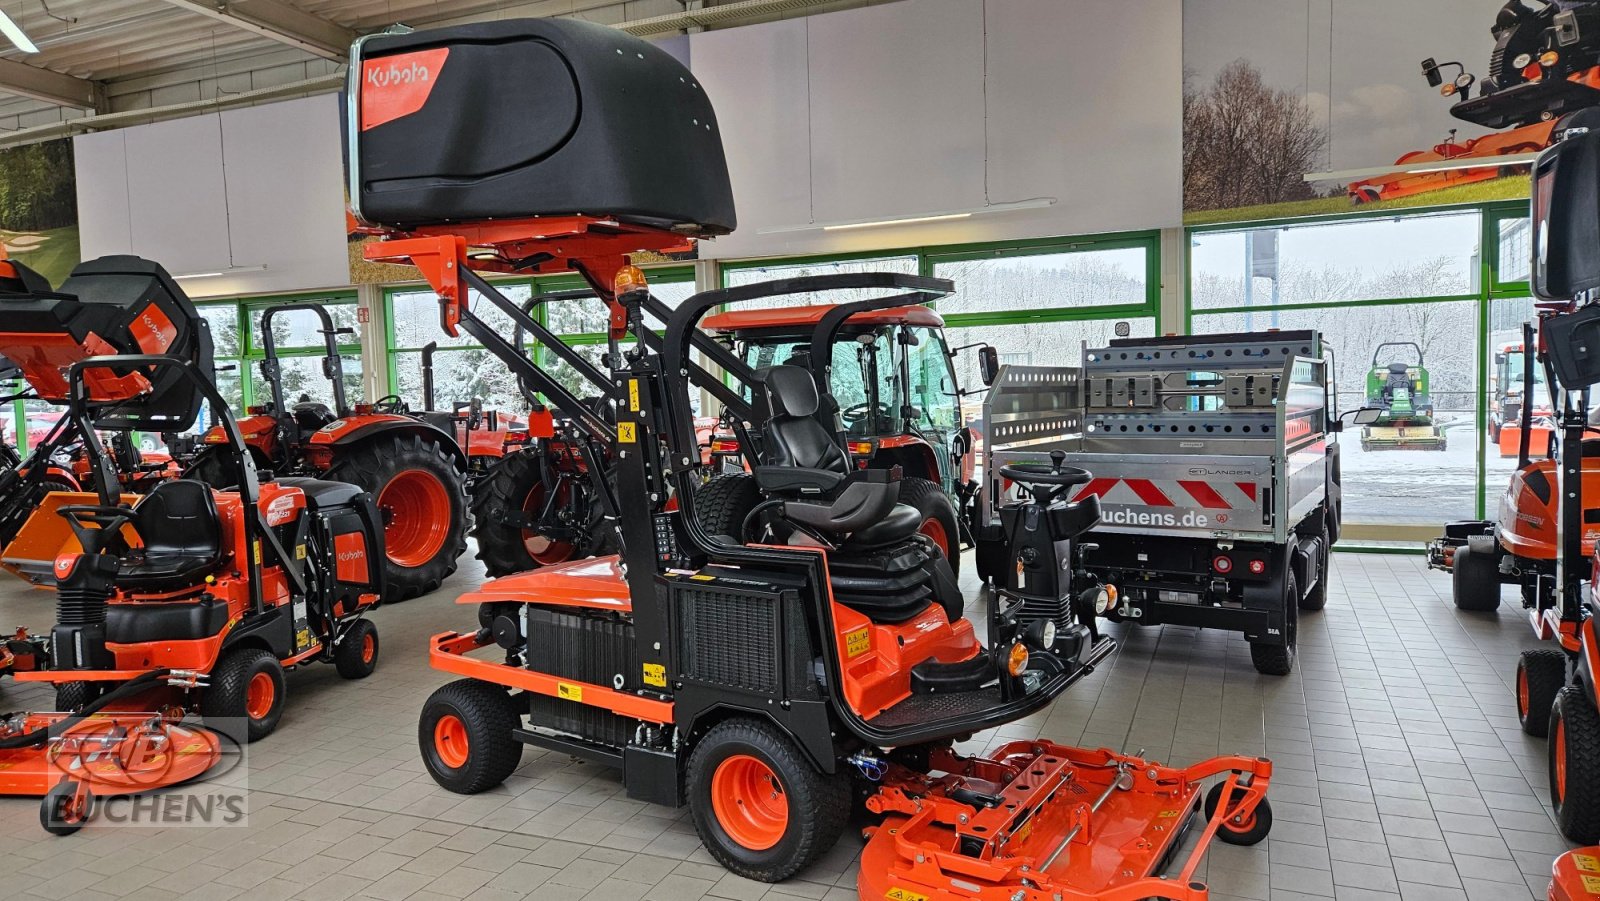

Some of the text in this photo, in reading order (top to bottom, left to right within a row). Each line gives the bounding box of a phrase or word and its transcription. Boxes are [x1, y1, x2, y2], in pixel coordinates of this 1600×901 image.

[367, 61, 429, 88] Kubota
[142, 314, 167, 346] Kubota
[1102, 508, 1208, 527] uchens.de
[338, 549, 364, 561] Kubota
